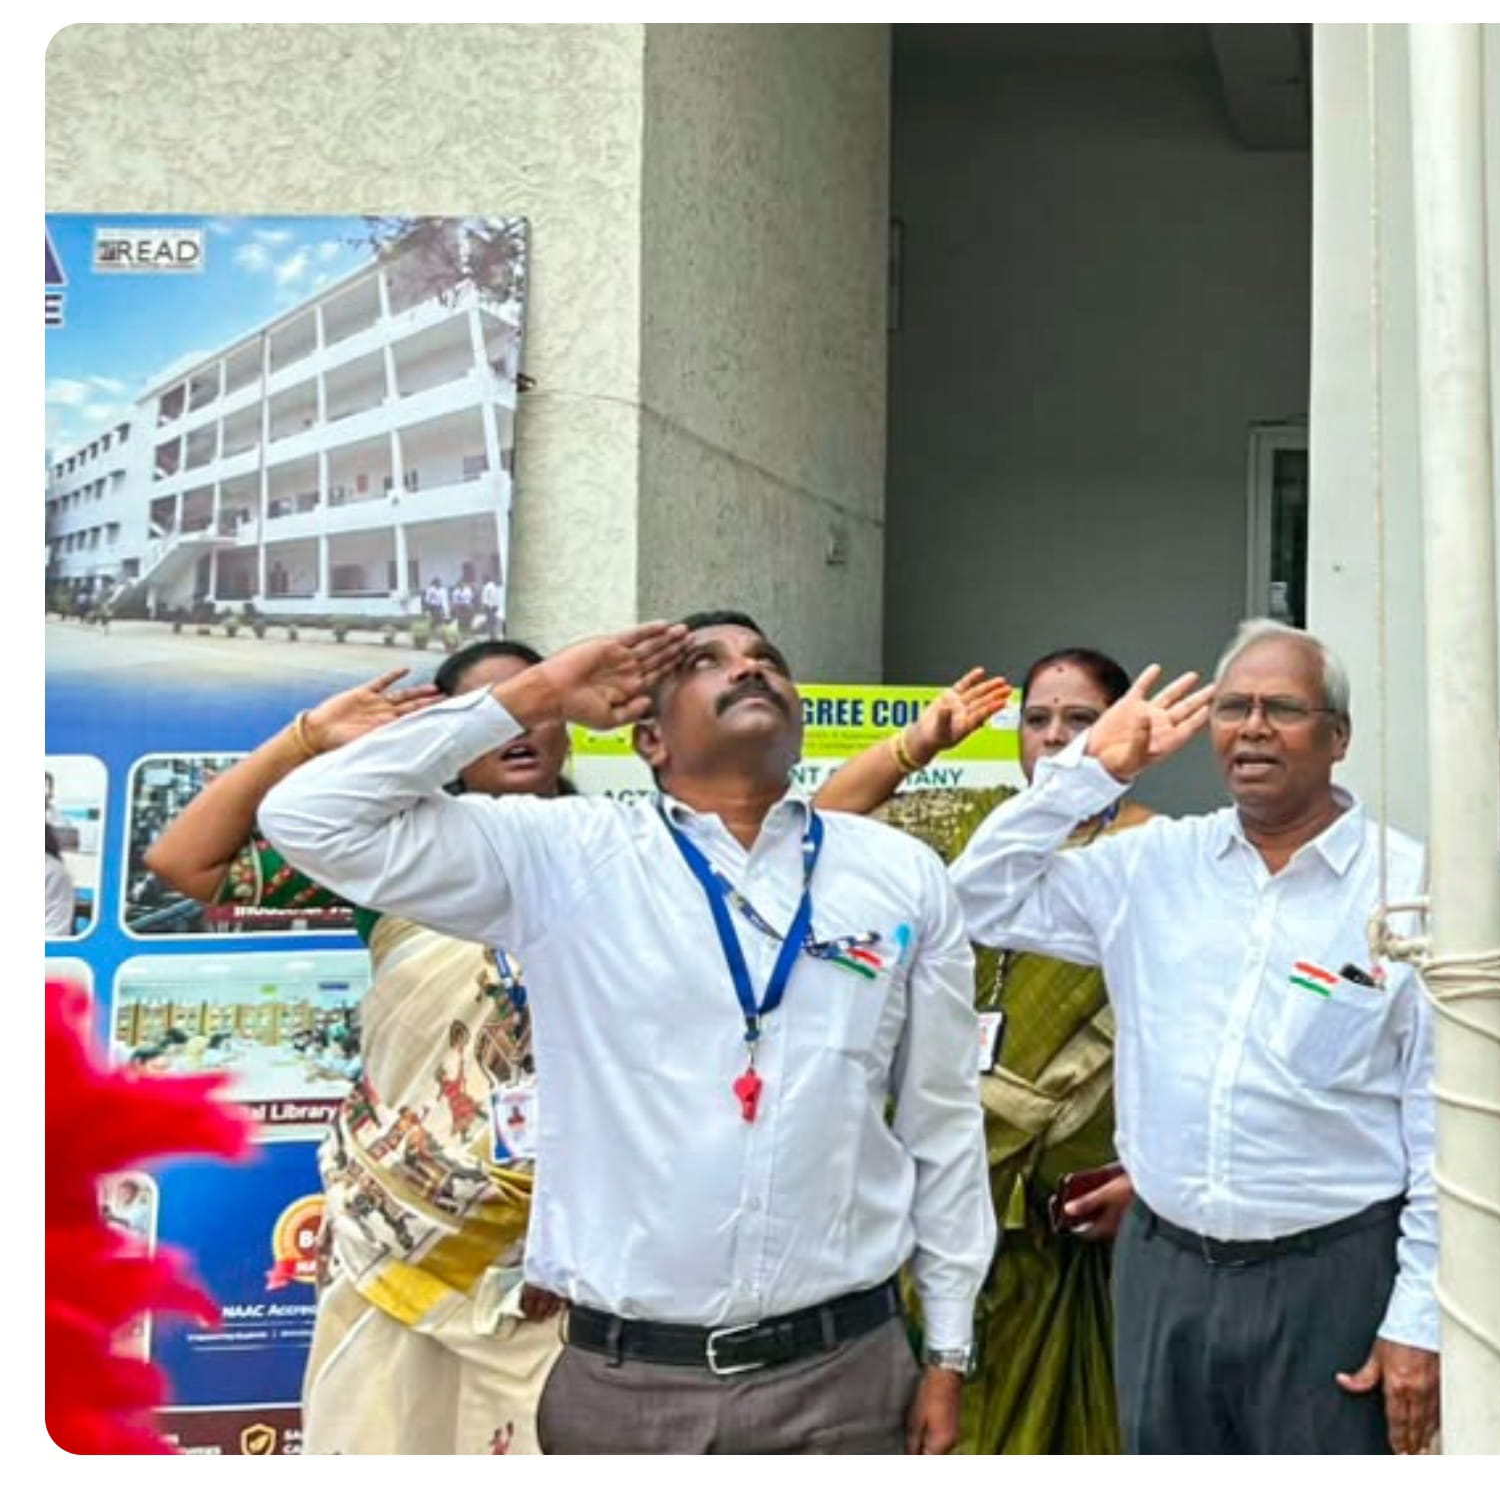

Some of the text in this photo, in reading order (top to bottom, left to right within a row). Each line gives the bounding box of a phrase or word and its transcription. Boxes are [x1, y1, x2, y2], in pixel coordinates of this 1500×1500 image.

[117, 239, 199, 263] READ
[803, 698, 864, 726] GREE
[907, 767, 964, 785] TANY
[271, 1102, 338, 1123] Library
[222, 1304, 265, 1318] NAAC
